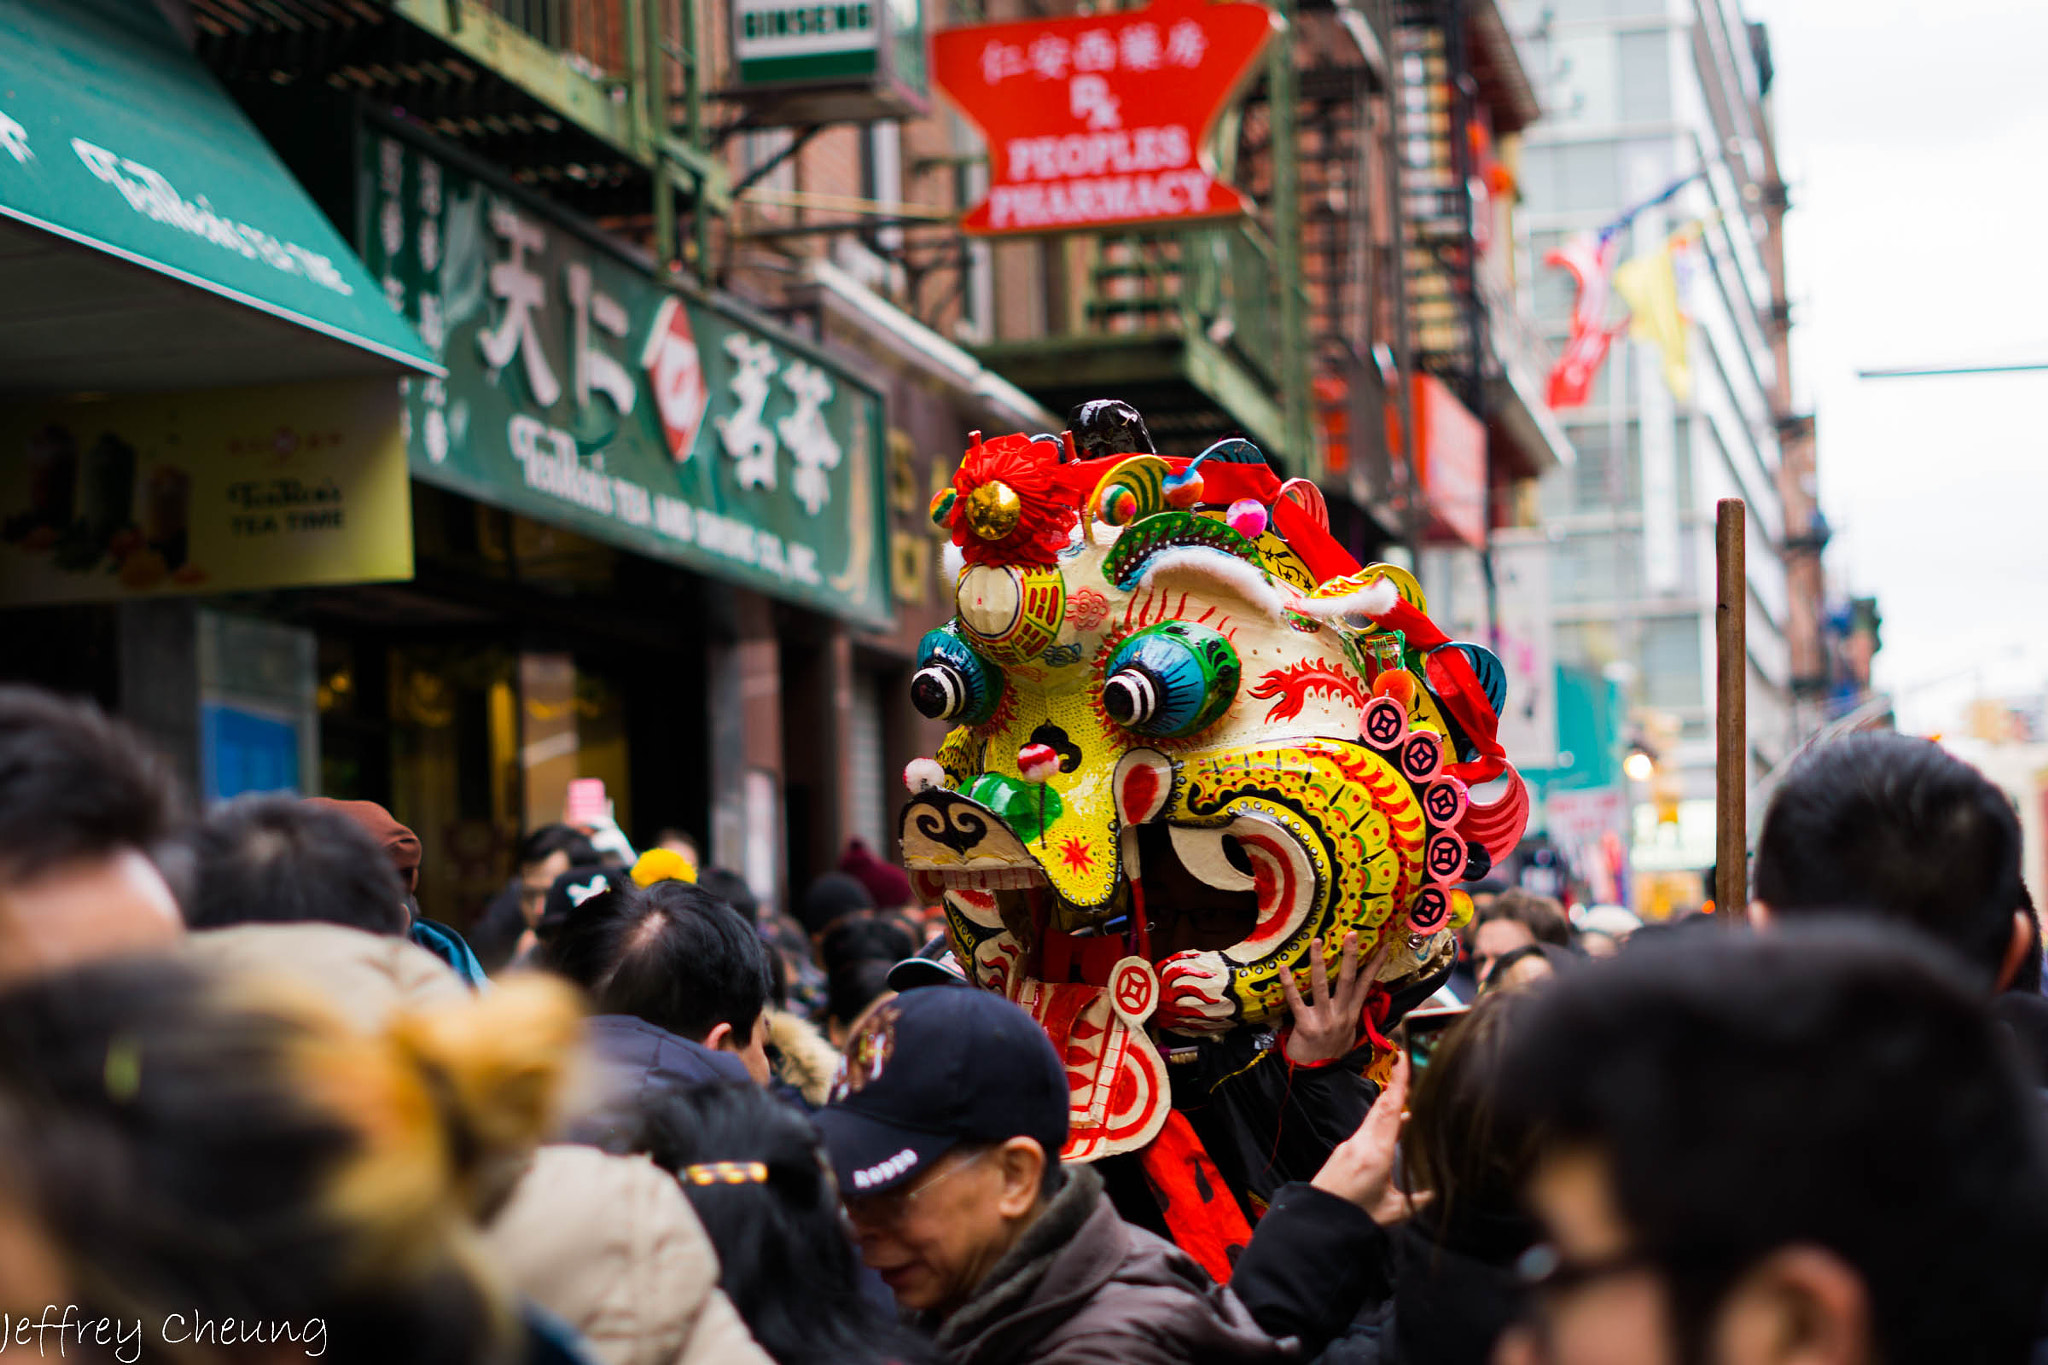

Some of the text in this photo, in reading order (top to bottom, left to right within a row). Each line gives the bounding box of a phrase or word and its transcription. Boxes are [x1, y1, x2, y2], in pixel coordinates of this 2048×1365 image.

[741, 2, 875, 39] GINSENG
[1008, 124, 1191, 182] PEOPLES
[988, 167, 1211, 229] PHARMACY
[231, 509, 343, 537] TEA TIME
